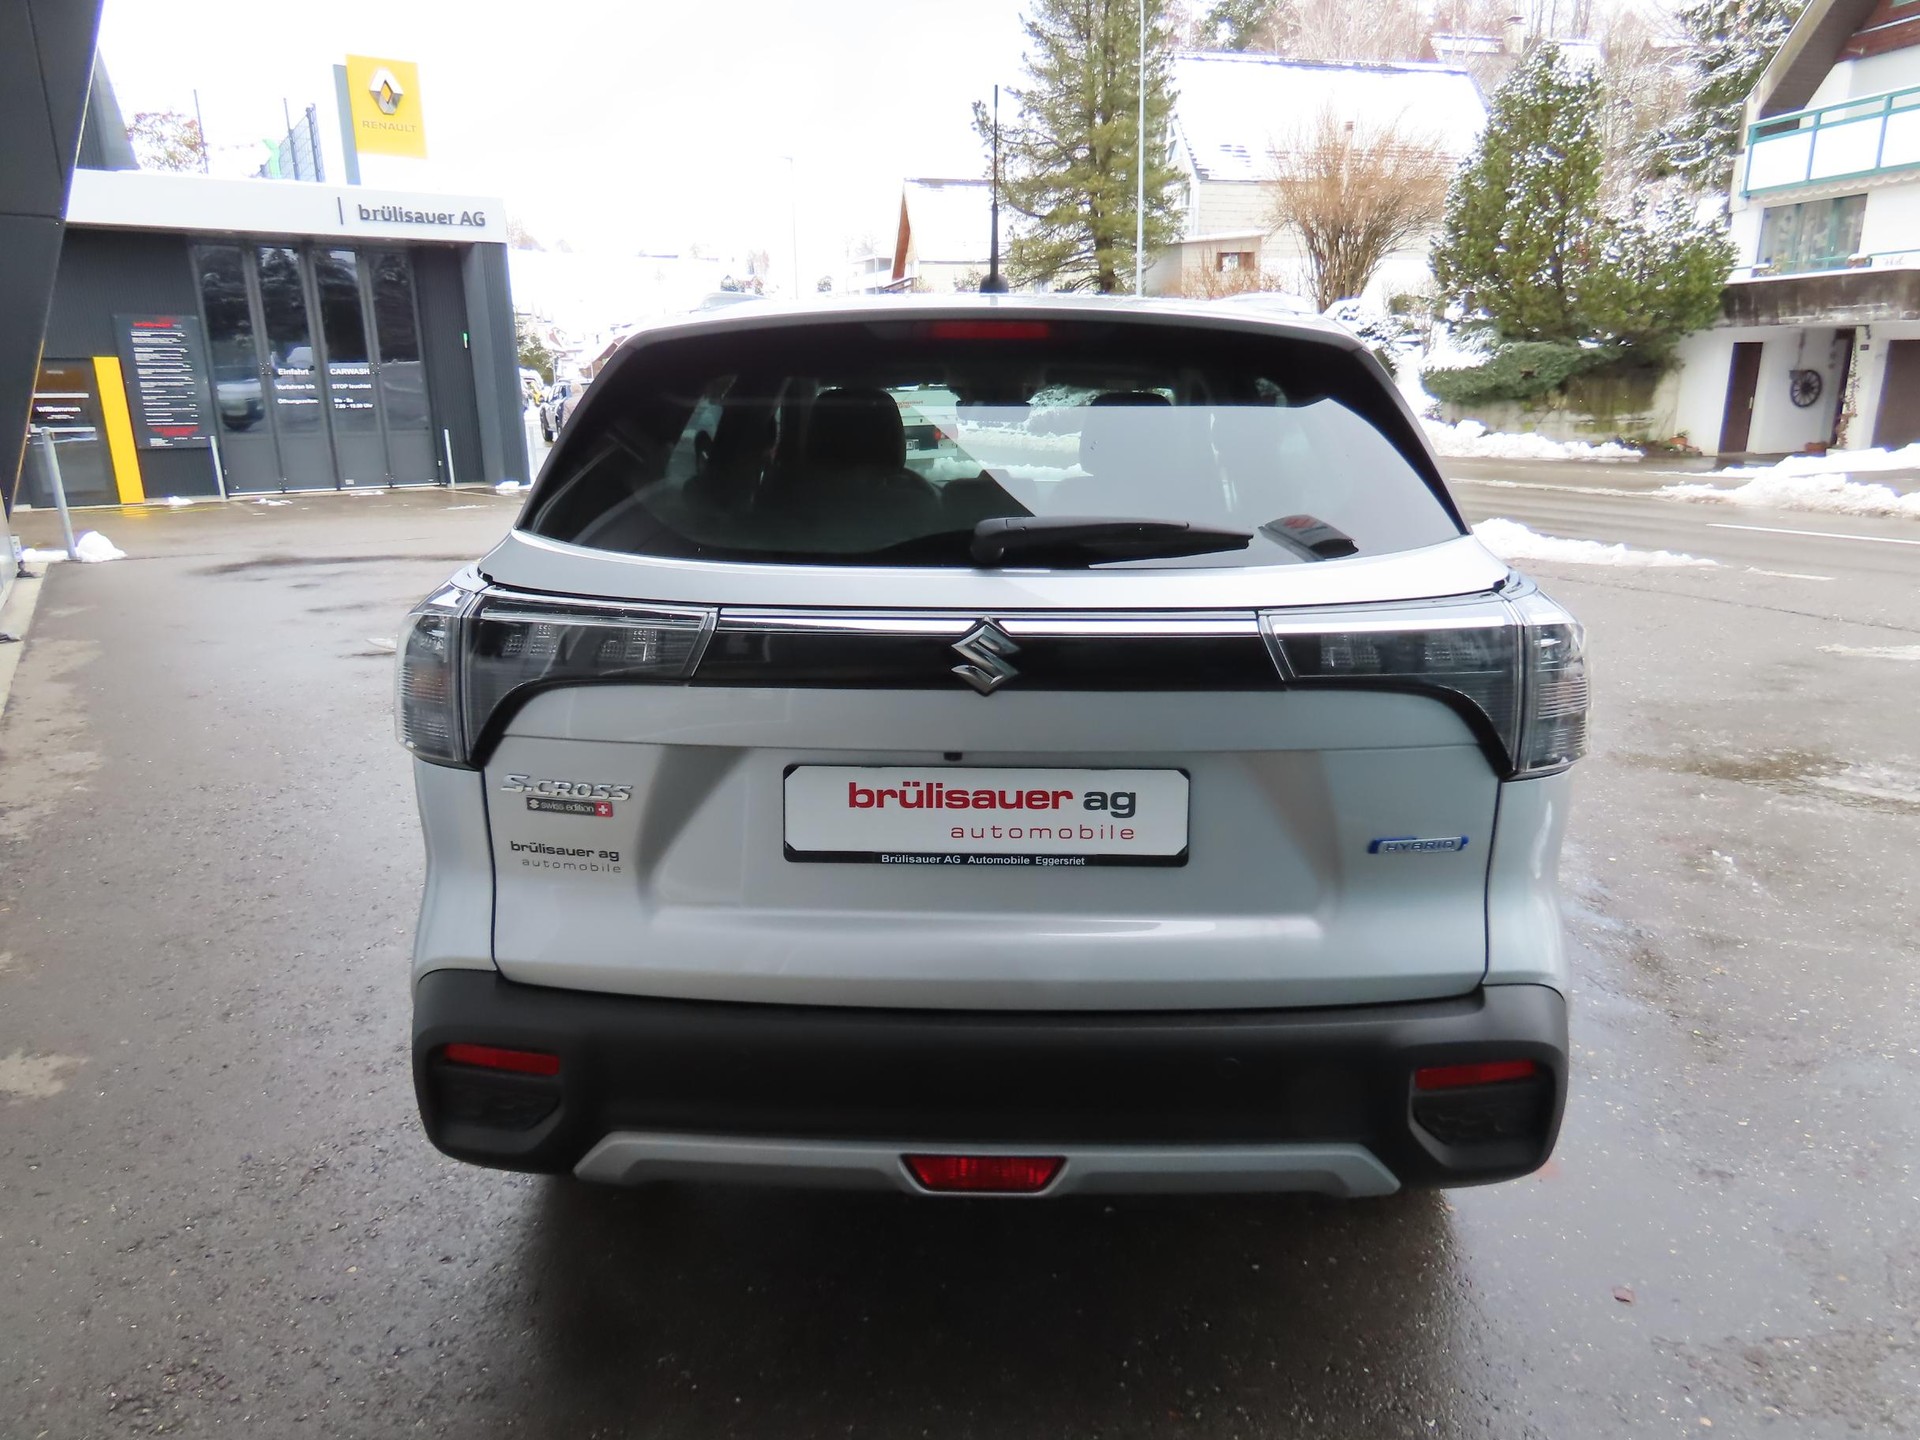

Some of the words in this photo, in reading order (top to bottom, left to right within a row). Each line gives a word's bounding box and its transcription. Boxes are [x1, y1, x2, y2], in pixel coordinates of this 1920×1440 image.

[362, 120, 416, 132] RENAULT
[358, 203, 455, 225] brülisauer
[459, 211, 486, 227] AG
[848, 781, 1074, 810] brülisauer
[1083, 790, 1137, 819] ag
[541, 802, 564, 811] swiss
[565, 803, 595, 813] edition
[950, 824, 1136, 840] automobile
[510, 841, 594, 858] brülisauer
[598, 850, 620, 861] ag
[1386, 840, 1455, 852] HYBRID
[522, 859, 622, 873] automobile
[881, 854, 941, 865] Brülisauer
[943, 855, 961, 865] AG
[967, 855, 1030, 865] Automobile
[1035, 856, 1086, 867] Eggersriet
